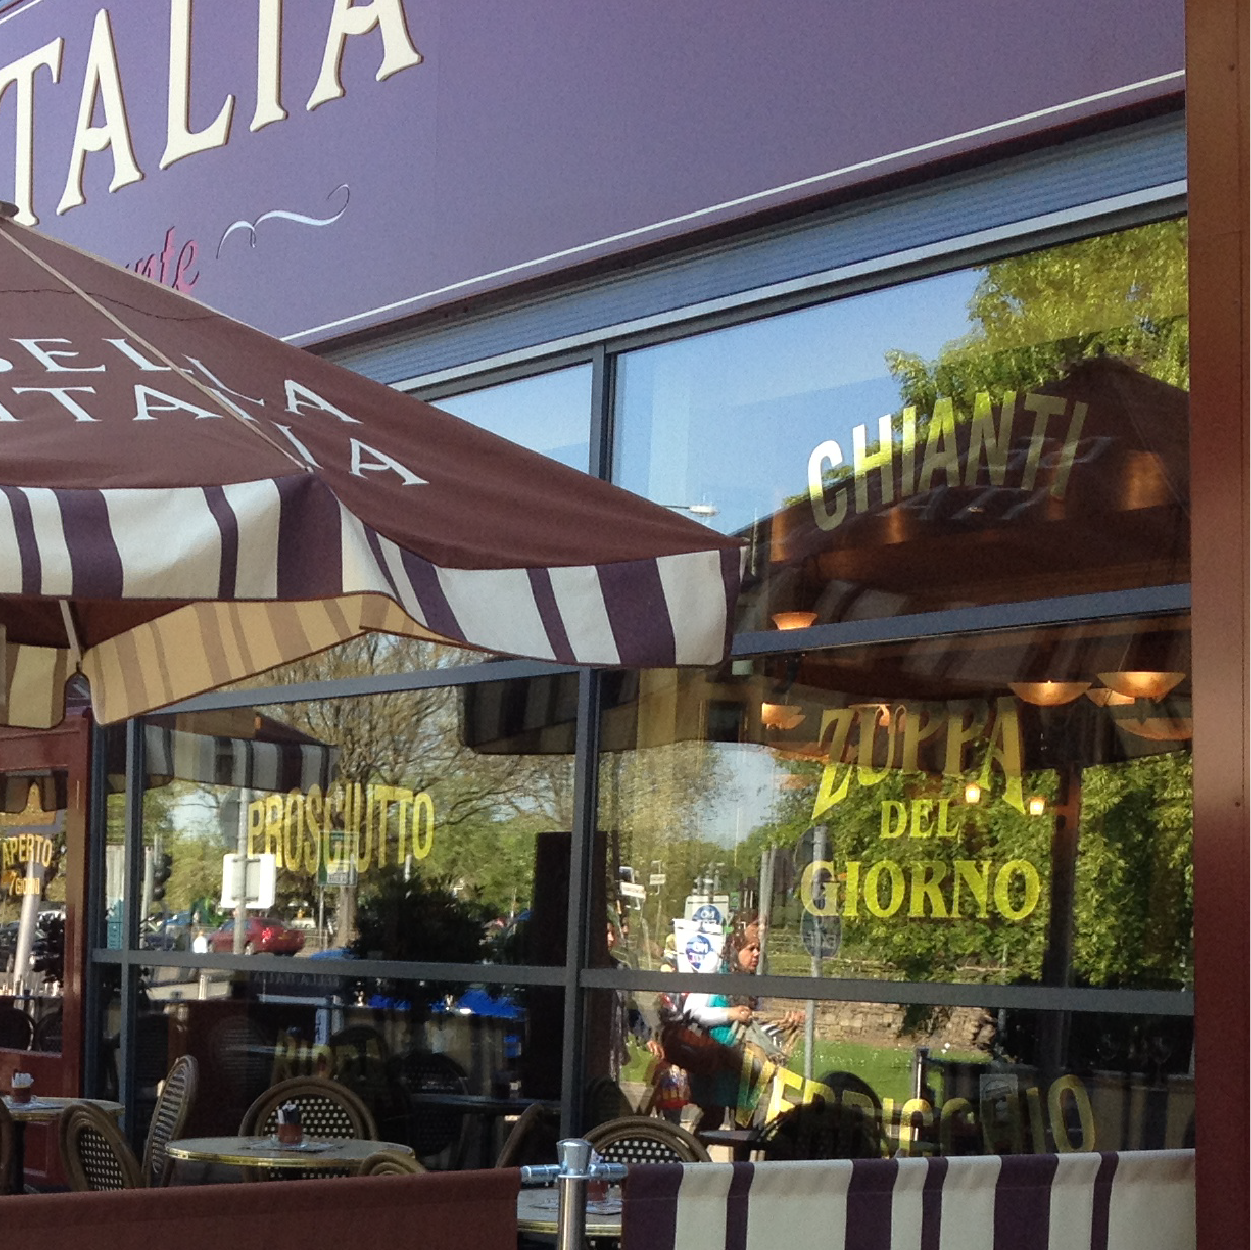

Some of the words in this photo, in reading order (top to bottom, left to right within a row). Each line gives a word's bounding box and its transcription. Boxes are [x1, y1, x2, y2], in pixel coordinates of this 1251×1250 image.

[807, 391, 1088, 532] CHIANTI
[812, 696, 1026, 820] ZUPPA
[2, 833, 53, 869] APERTO
[247, 783, 435, 875] PROSCIUTTO
[880, 799, 960, 839] DEL
[800, 859, 1041, 921] GIORNO
